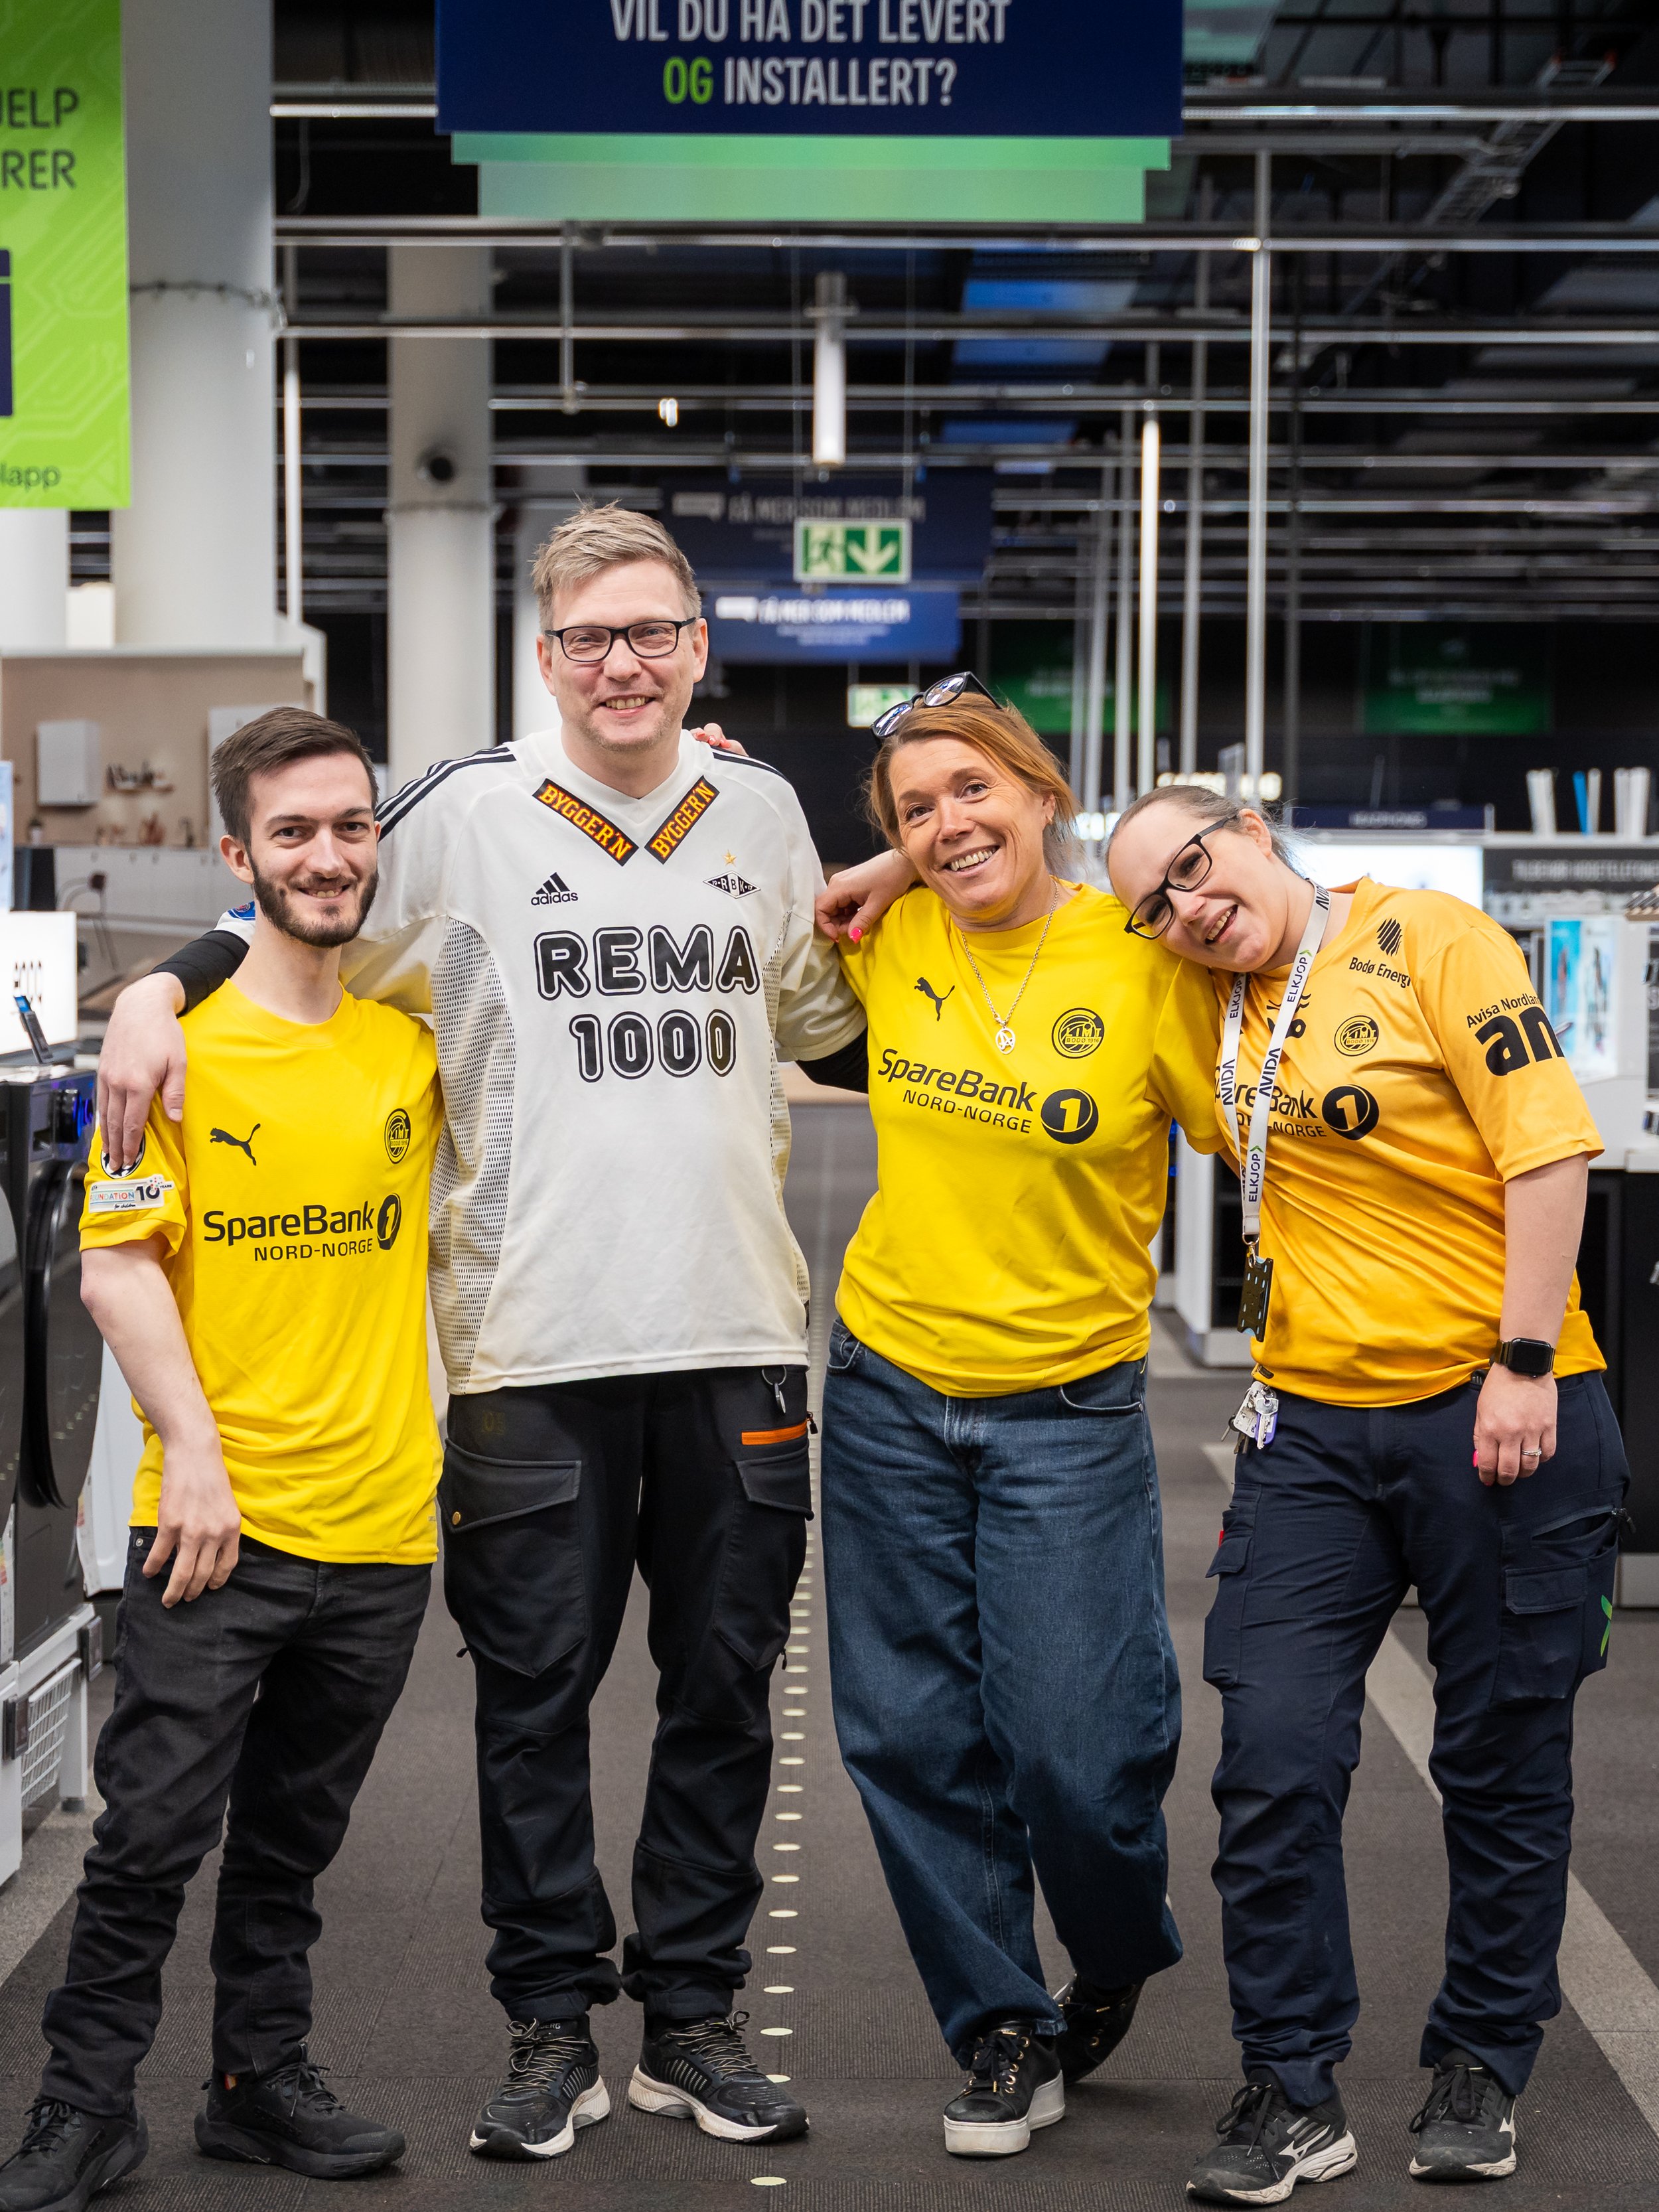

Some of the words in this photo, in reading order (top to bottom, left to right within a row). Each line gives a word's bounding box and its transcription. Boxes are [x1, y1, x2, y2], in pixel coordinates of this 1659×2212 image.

[611, 0, 668, 41] VIL
[678, 0, 729, 42] DU
[739, 0, 791, 42] HA
[800, 0, 865, 43] DET
[879, 0, 1011, 44] LEVERT
[664, 56, 713, 104] OG
[724, 56, 957, 106] INSTALLERT?
[0, 88, 80, 129] ELP
[539, 784, 632, 861] BYGGER'N
[651, 781, 716, 859] BYGGER'N
[531, 890, 578, 905] adidas
[534, 924, 760, 1001] REMA
[1349, 957, 1376, 974] Bodø
[1467, 1004, 1500, 1028] Avisa
[569, 1009, 736, 1082] 1000
[877, 1049, 1038, 1112] SpareBank
[902, 1089, 1032, 1134] NORD-NORGE
[203, 1201, 374, 1246] SpareBank
[254, 1238, 372, 1262] NORD-NORGE
